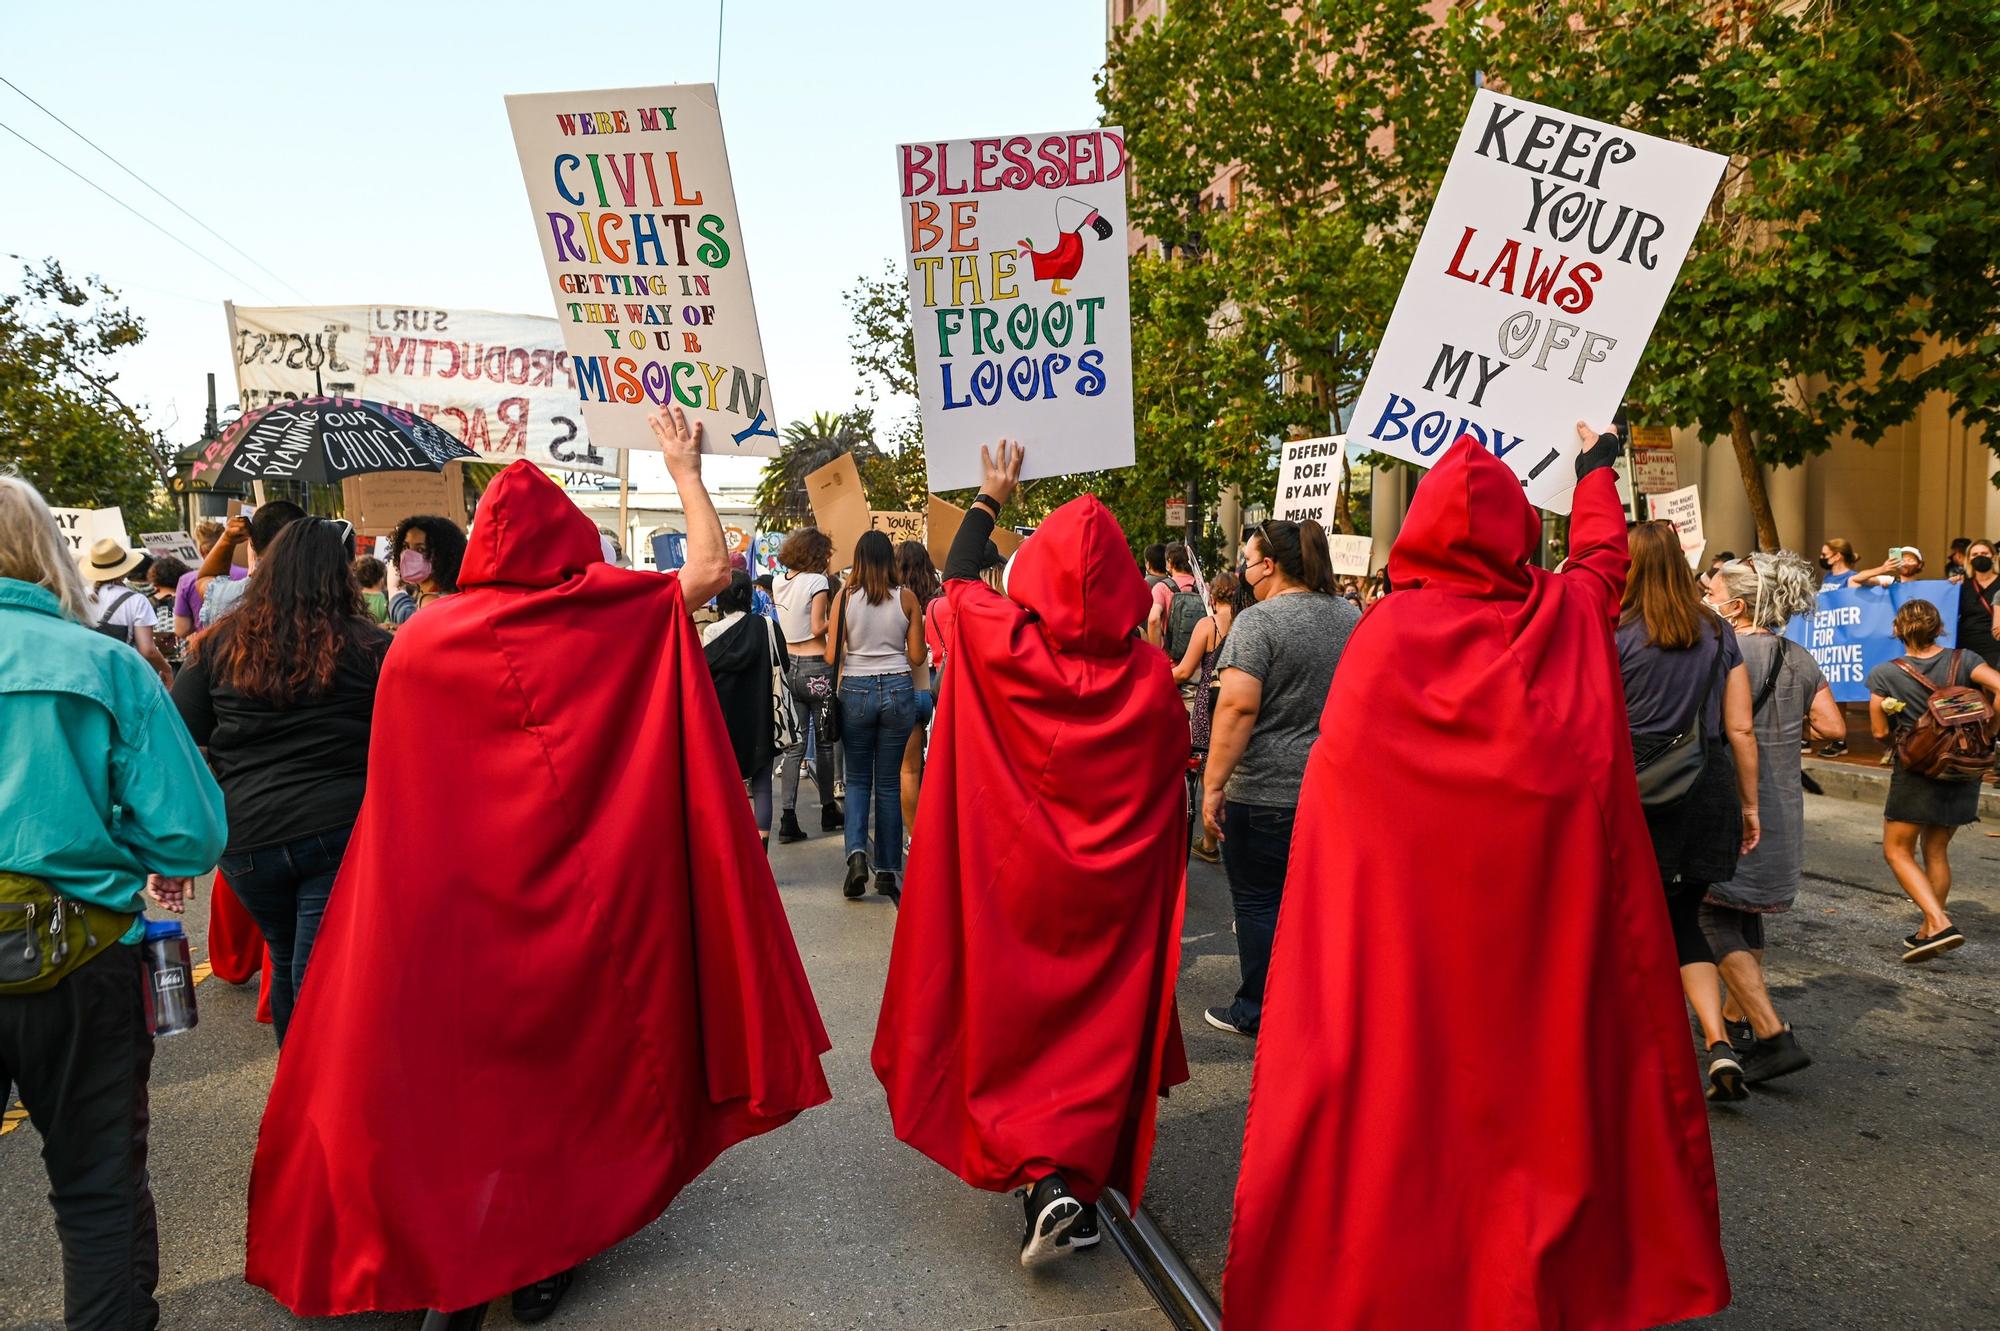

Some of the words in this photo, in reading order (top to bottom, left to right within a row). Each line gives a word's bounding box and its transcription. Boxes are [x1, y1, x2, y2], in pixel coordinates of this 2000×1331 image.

[556, 110, 630, 136] WERE
[638, 107, 677, 131] MY
[1475, 102, 1636, 190] KEEP
[554, 152, 703, 207] CIVIL
[901, 131, 1125, 197] BLESSED
[546, 211, 731, 268] RIGHTS
[910, 201, 979, 253] BE
[1523, 177, 1664, 270] YOUR
[559, 274, 667, 296] GETTING
[679, 274, 710, 296] IN
[913, 249, 1019, 307] THE
[1444, 227, 1603, 314] LAWS
[567, 302, 619, 324] THE
[624, 304, 673, 325] WAY
[683, 305, 715, 325] OF
[935, 296, 1105, 357] FROOT
[604, 329, 702, 353] YOUR
[1499, 310, 1617, 384] OFF
[572, 355, 778, 446] MISOGYNY
[940, 350, 1107, 410] LOOPS
[1422, 344, 1510, 407] MY
[234, 410, 299, 475] FAMILY
[263, 411, 320, 476] PLANNING
[325, 410, 385, 430] OUR
[322, 430, 430, 471] CHOICE
[1289, 442, 1337, 460] DEFEND
[1294, 463, 1327, 480] ROE!
[1635, 452, 1647, 464] NO
[1648, 455, 1675, 464] PARKING
[1285, 507, 1322, 521] MEANS
[1286, 485, 1302, 499] BY
[1303, 482, 1331, 498] ANY
[1812, 628, 1834, 646] FOR
[1814, 606, 1861, 629] CENTER
